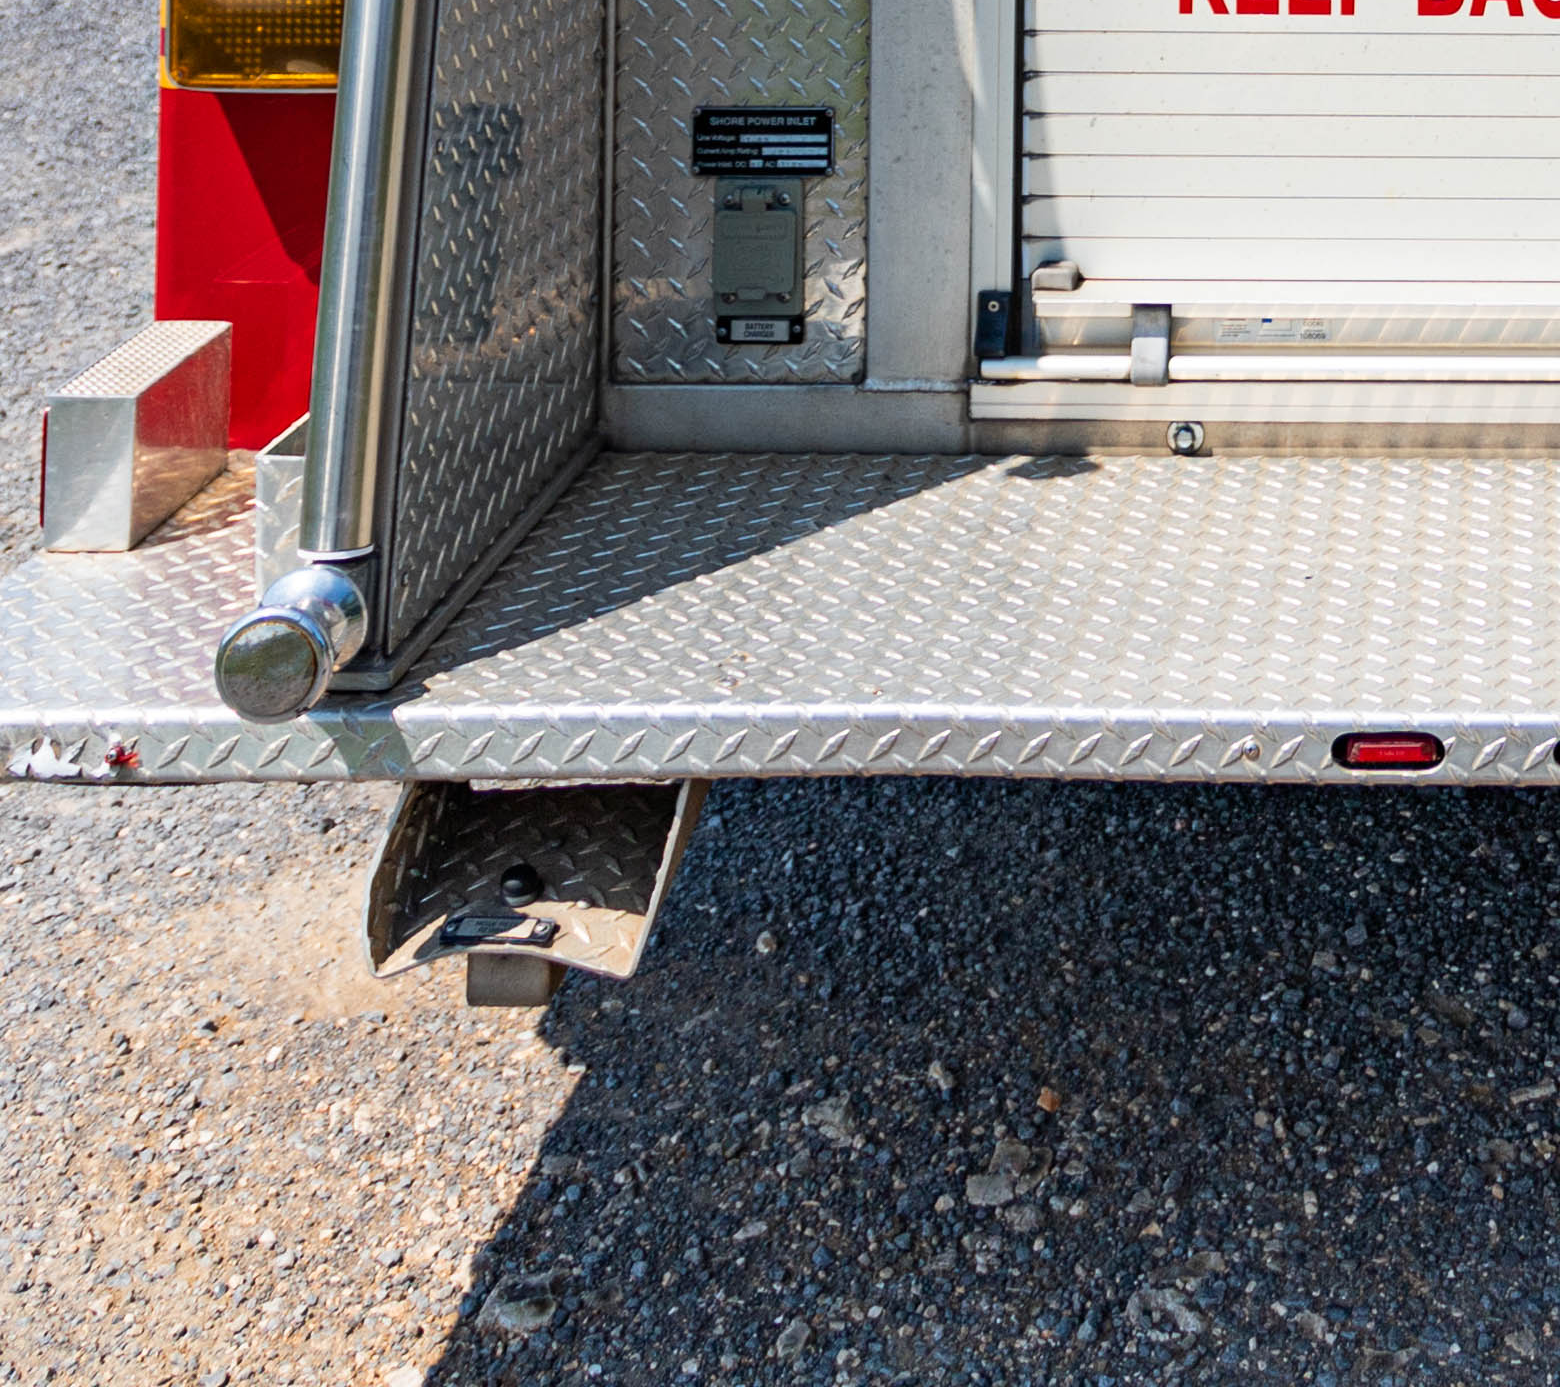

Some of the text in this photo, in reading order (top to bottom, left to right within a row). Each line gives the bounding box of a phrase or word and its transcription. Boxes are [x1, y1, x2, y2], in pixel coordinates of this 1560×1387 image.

[709, 116, 816, 126] SHORE POWER INLET
